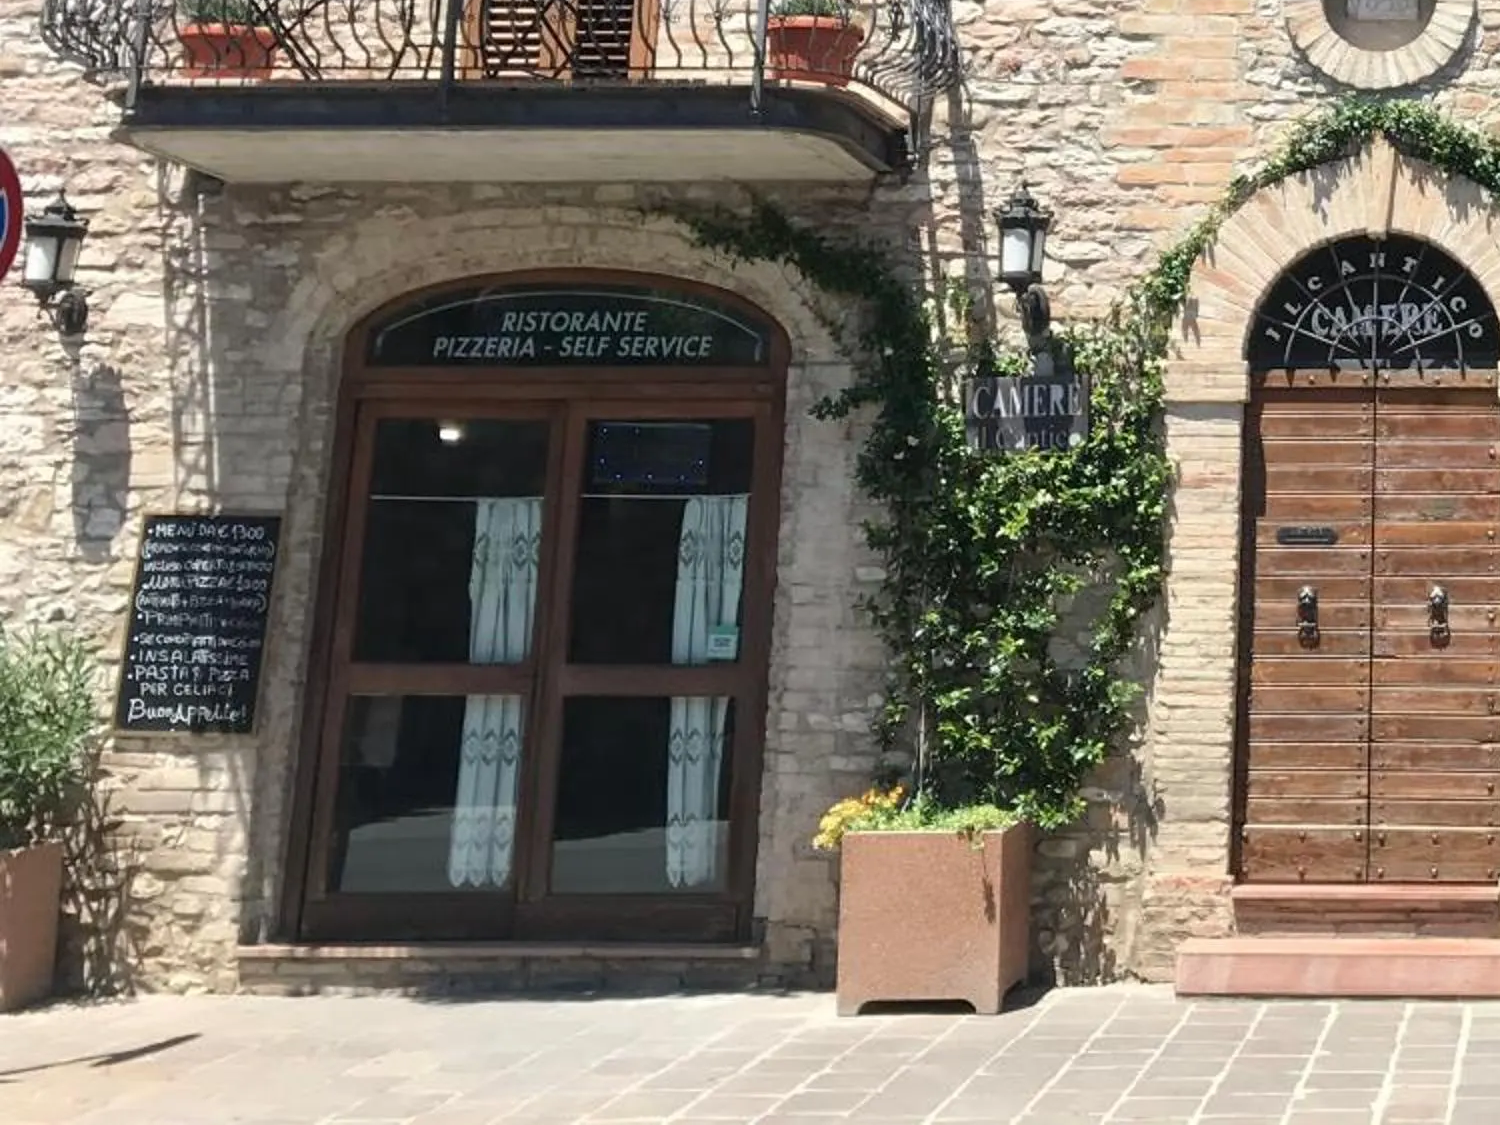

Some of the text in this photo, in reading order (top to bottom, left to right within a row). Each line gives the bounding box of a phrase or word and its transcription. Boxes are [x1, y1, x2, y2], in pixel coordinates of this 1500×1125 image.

[1307, 252, 1484, 339] CANTICO
[501, 311, 648, 332] RISTORANTE
[1311, 300, 1444, 338] CAMERE
[433, 336, 535, 358] PIZZERIA
[559, 335, 611, 358] SELF
[616, 335, 713, 357] SERVICE
[973, 384, 1083, 420] CAMERE
